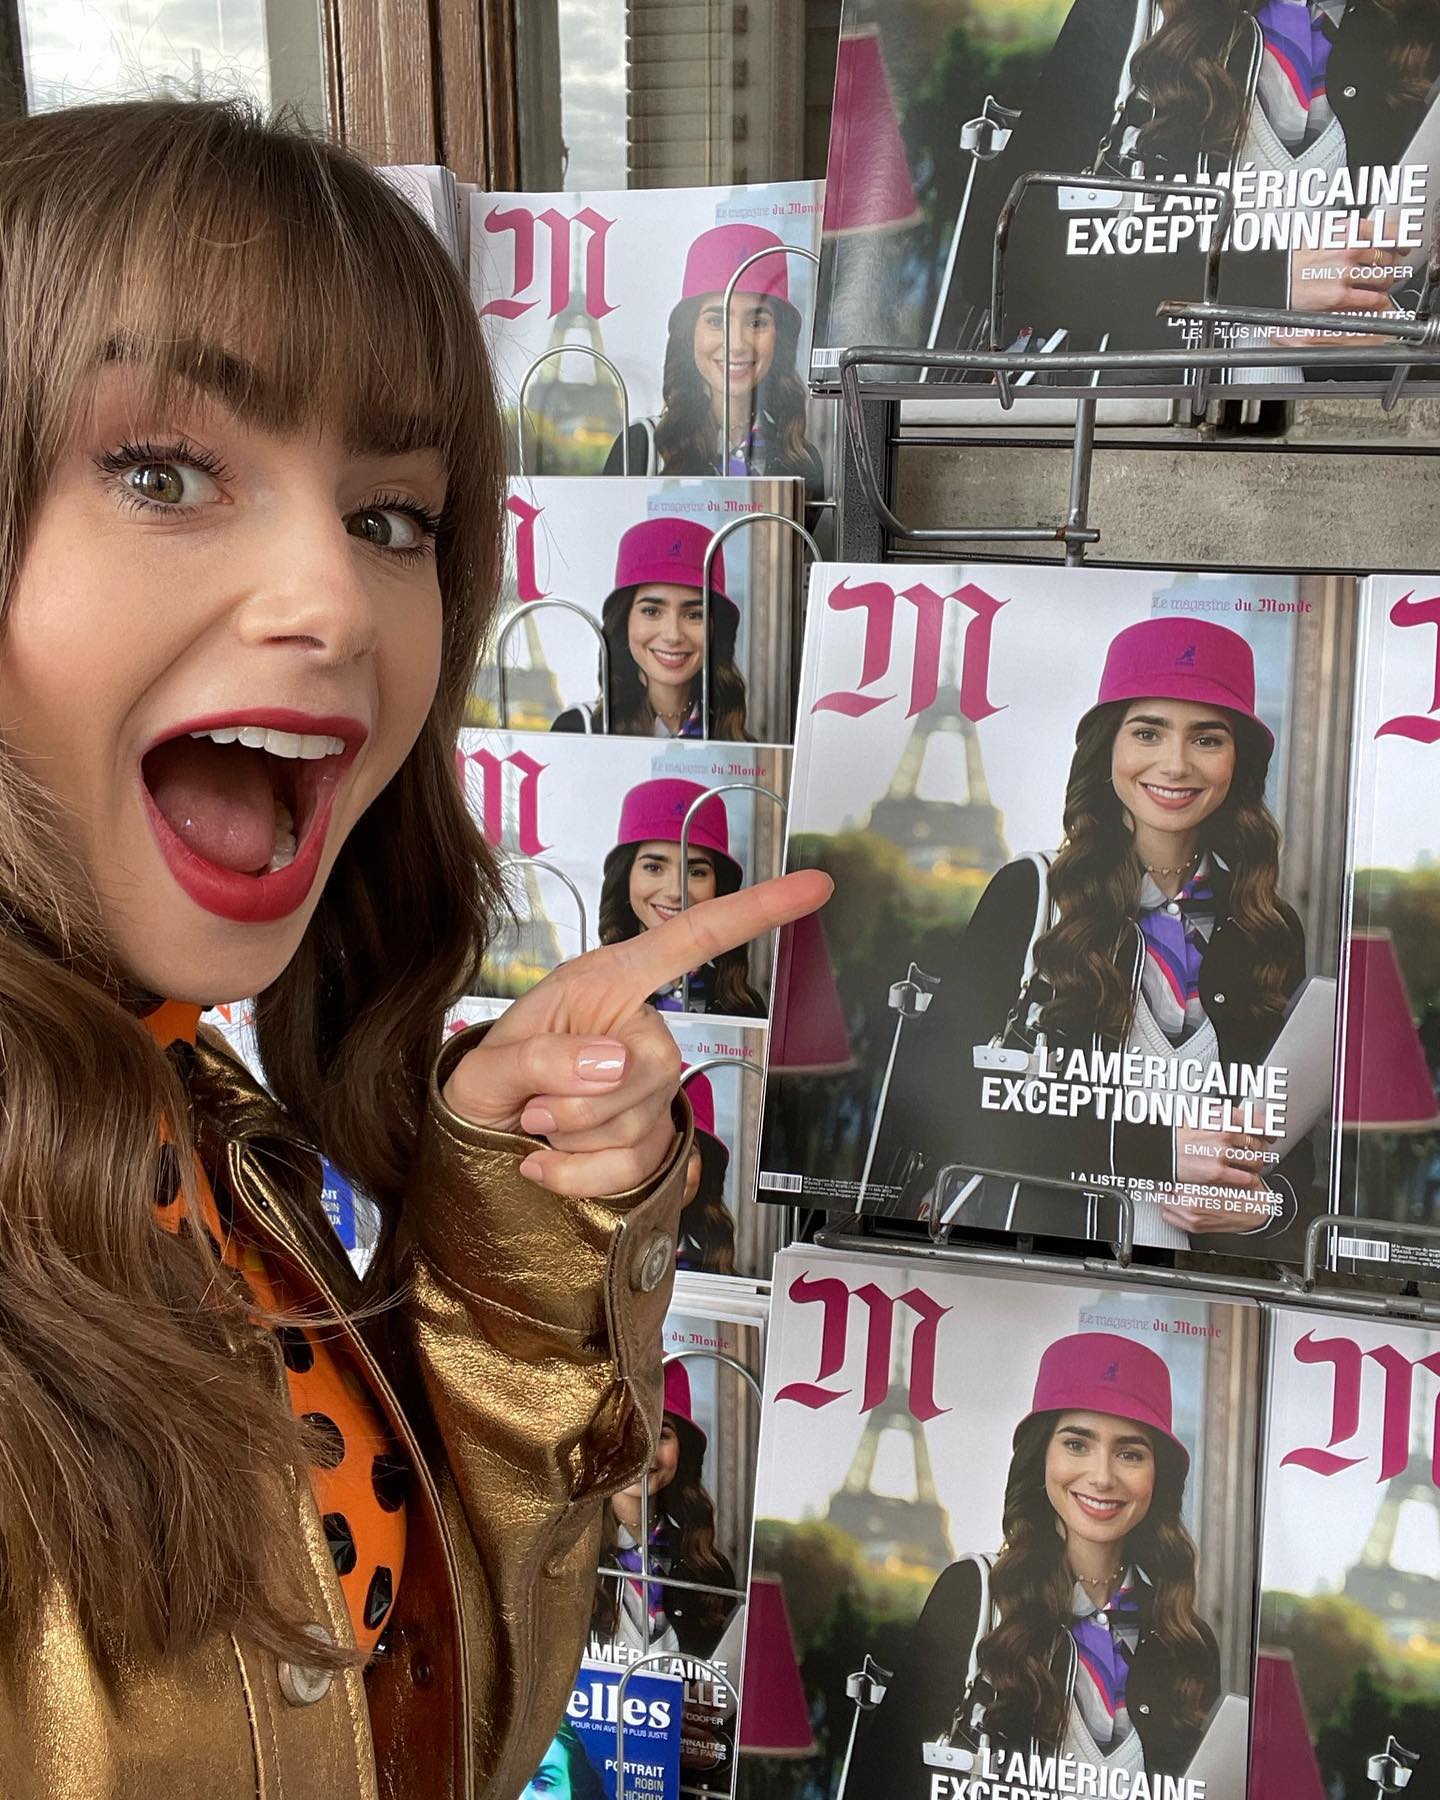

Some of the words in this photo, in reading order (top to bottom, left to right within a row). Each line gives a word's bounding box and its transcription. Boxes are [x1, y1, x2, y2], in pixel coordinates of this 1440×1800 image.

[773, 203, 785, 216] du
[479, 203, 621, 321] M
[1301, 267, 1346, 280] EMILY
[1349, 265, 1414, 279] COOPER
[708, 499, 720, 513] du
[724, 500, 764, 513] Monde
[1171, 598, 1232, 614] magazine
[1234, 597, 1252, 612] du
[1258, 597, 1313, 614] Monde
[811, 575, 1012, 723] M
[711, 763, 724, 775] du
[728, 763, 767, 777] Monde
[697, 1041, 710, 1054] du
[714, 1043, 753, 1058] Monde
[1038, 1045, 1289, 1100] L'AMÉRICAINE
[980, 1076, 1287, 1138] EXCEPTIONNELLE
[1184, 1143, 1223, 1157] EMILY
[1225, 1148, 1280, 1164] COOPER
[1090, 1173, 1126, 1188] LISTE
[1128, 1177, 1155, 1190] DES
[1158, 1180, 1173, 1193] 10
[1174, 1183, 1284, 1204] PERSONNALITÉS
[1145, 1192, 1222, 1211] INFLUENTES
[1224, 1200, 1243, 1213] DE
[1244, 1203, 1284, 1217] PARIS
[1152, 1318, 1169, 1333] du
[1173, 1319, 1222, 1338] Monde
[671, 1331, 685, 1342] du
[689, 1332, 730, 1350] Monde
[774, 1270, 954, 1423] M
[686, 1712, 724, 1726] COOPER
[570, 1720, 591, 1730] POUR
[604, 1725, 628, 1735] AVER
[629, 1728, 647, 1738] PLUS
[647, 1730, 669, 1741] JUSTE
[979, 1747, 1207, 1800] L'AMÉRICAINE
[634, 1777, 665, 1792] ROBIN
